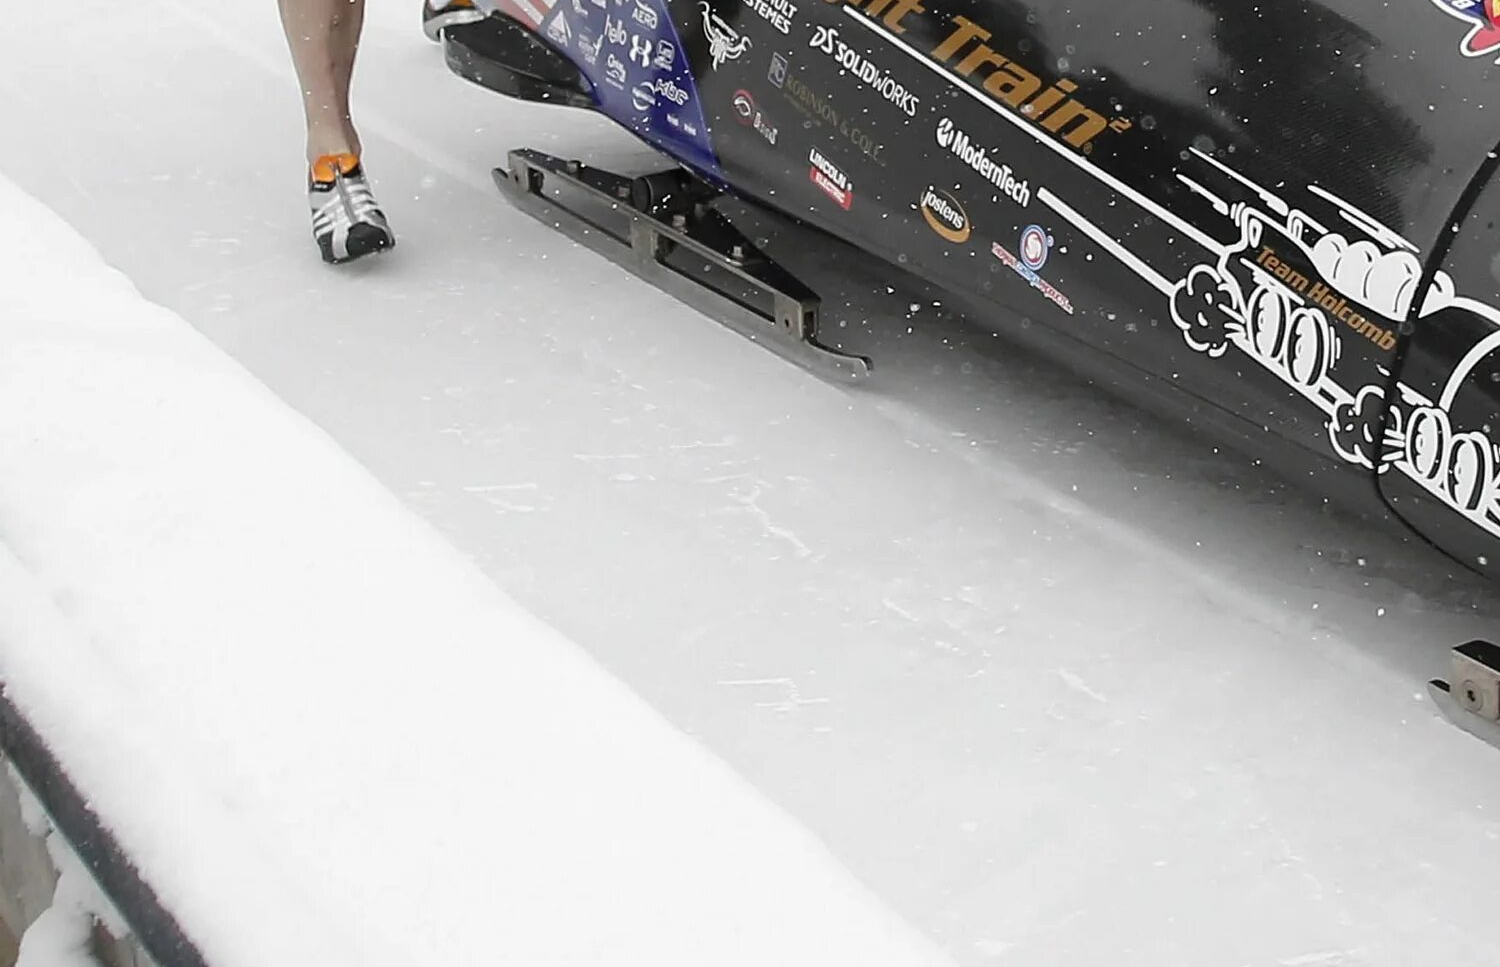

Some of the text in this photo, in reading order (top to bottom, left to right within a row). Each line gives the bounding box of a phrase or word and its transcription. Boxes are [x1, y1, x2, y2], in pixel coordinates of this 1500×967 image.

[785, 73, 838, 127] ROBINSON
[835, 41, 920, 116] SOLIDWORKS
[809, 148, 847, 190] LINCOLN
[951, 130, 1031, 208] ModernTech
[1256, 246, 1397, 351] Team Holcomb
